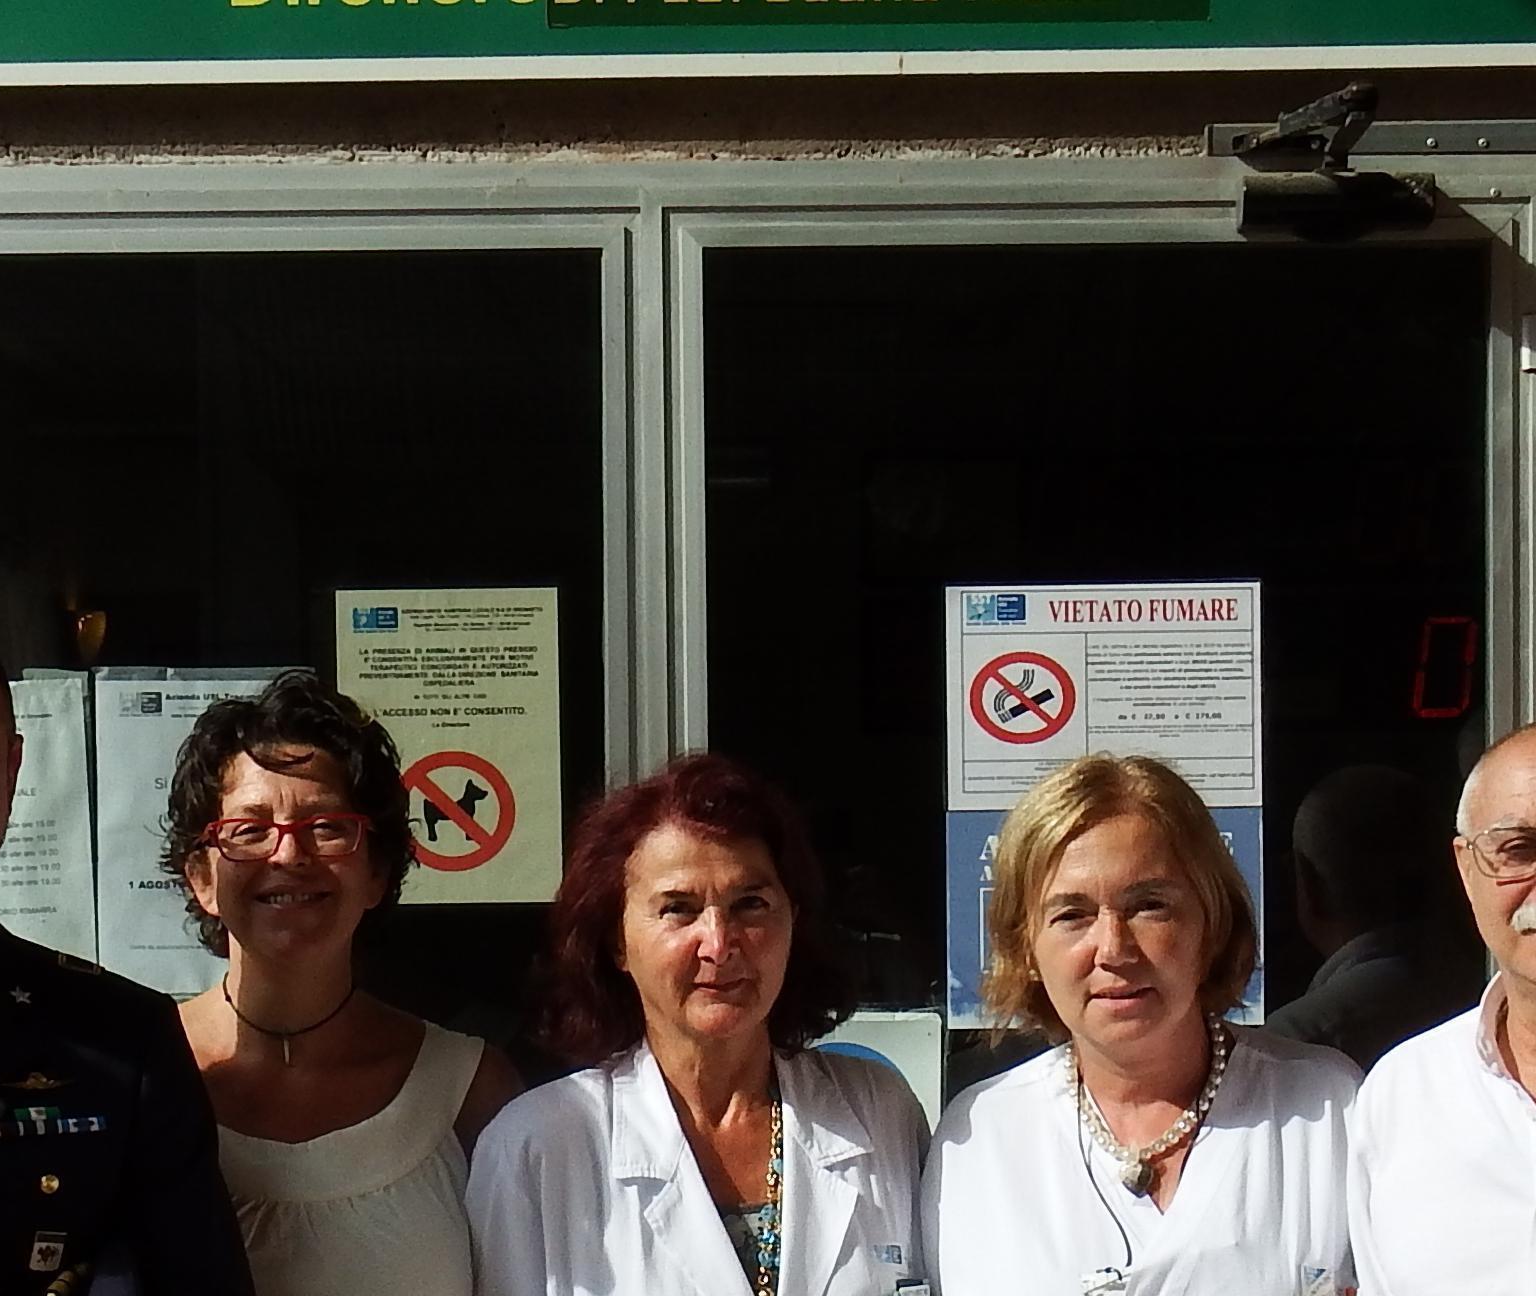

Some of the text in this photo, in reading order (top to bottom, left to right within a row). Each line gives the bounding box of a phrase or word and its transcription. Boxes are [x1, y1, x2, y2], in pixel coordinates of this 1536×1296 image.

[1049, 599, 1143, 623] VIETATO
[1149, 598, 1238, 622] FUMARE
[430, 706, 451, 716] NON
[129, 880, 178, 890] 1 AGOST
